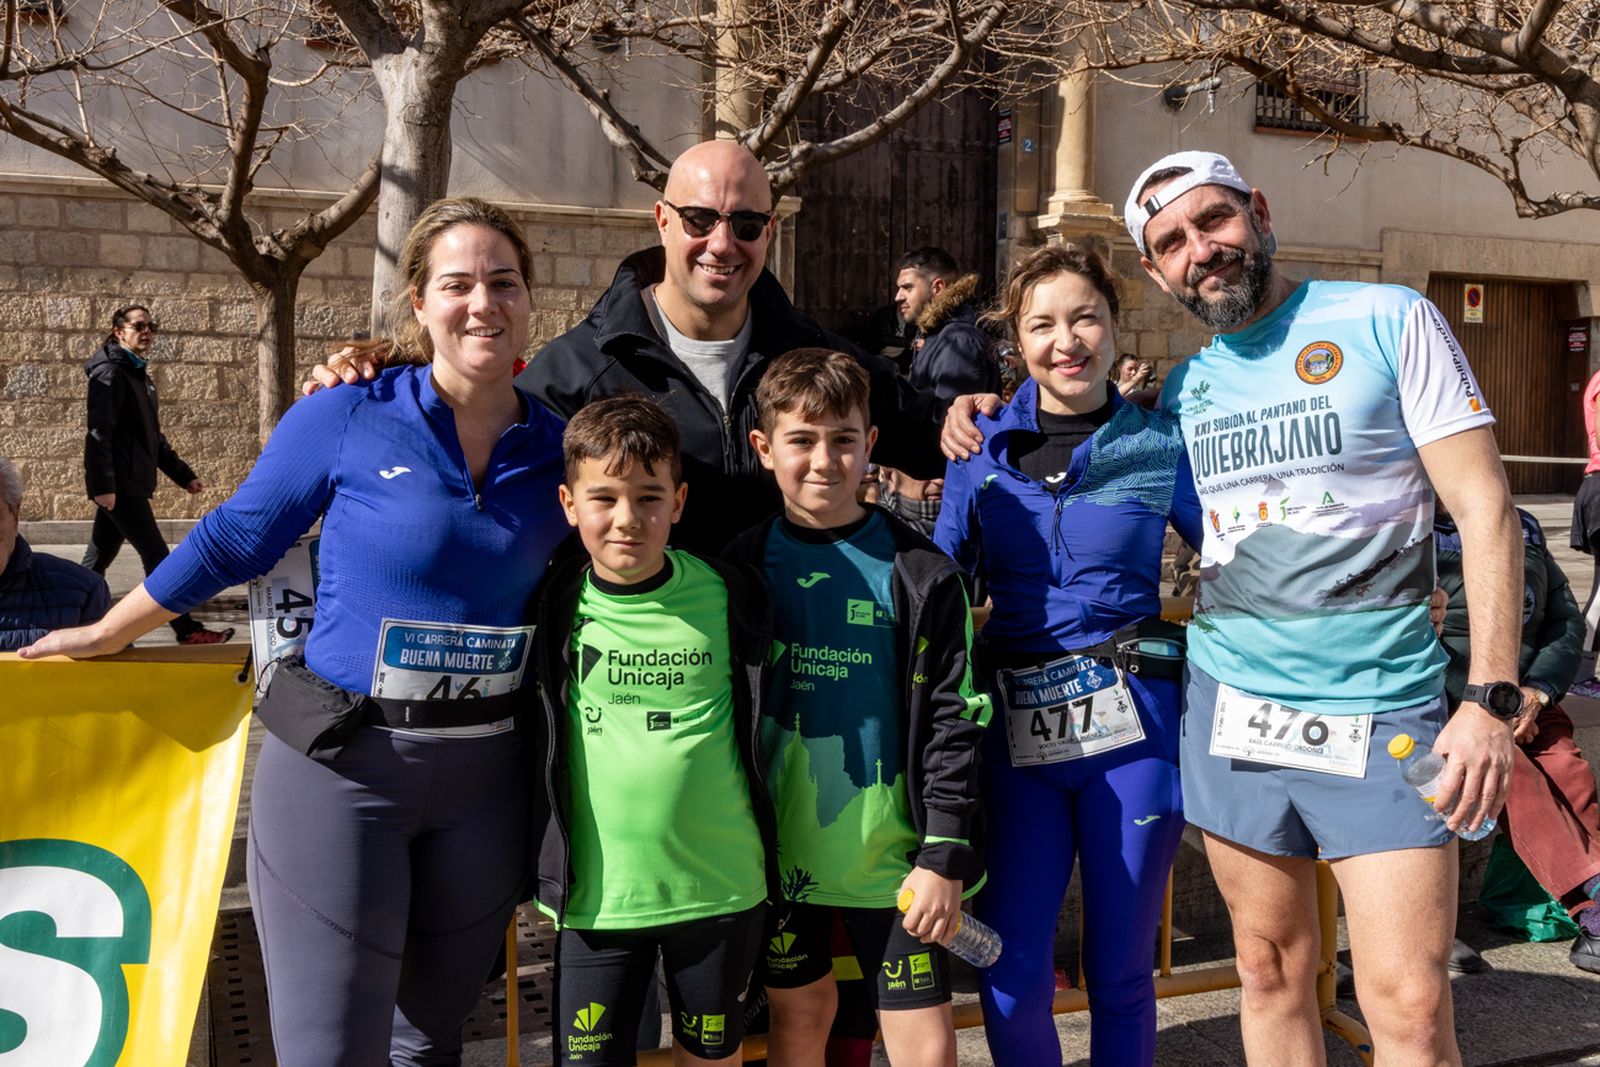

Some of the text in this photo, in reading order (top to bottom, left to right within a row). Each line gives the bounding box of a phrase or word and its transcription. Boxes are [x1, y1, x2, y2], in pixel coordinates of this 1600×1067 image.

[1024, 139, 1032, 152] 2
[1213, 413, 1245, 432] SUBIDA
[1246, 410, 1258, 425] AL
[1260, 399, 1306, 421] PANTANO
[1310, 395, 1332, 411] DEL
[1192, 412, 1343, 483] QUIEBRAJANO
[1208, 482, 1224, 494] QUE
[1223, 478, 1240, 490] UNA
[1276, 468, 1295, 480] UNA
[1295, 462, 1345, 477] TRADICIÓN
[404, 632, 517, 649] VI CARRERA CAMINATA
[400, 648, 495, 670] BUENA MUERTE
[607, 648, 713, 667] Fundación
[790, 643, 873, 664] Fundación
[607, 668, 684, 691] Unicaja
[790, 658, 849, 681] Unicaja
[789, 678, 815, 691] Jaén
[1038, 678, 1084, 703] MUERTE
[607, 692, 641, 705] Jaén
[1030, 695, 1094, 741] 477
[1247, 702, 1329, 746] 476
[887, 979, 907, 990] jaén
[568, 1032, 613, 1044] Fundación
[568, 1042, 601, 1052] Unicaja
